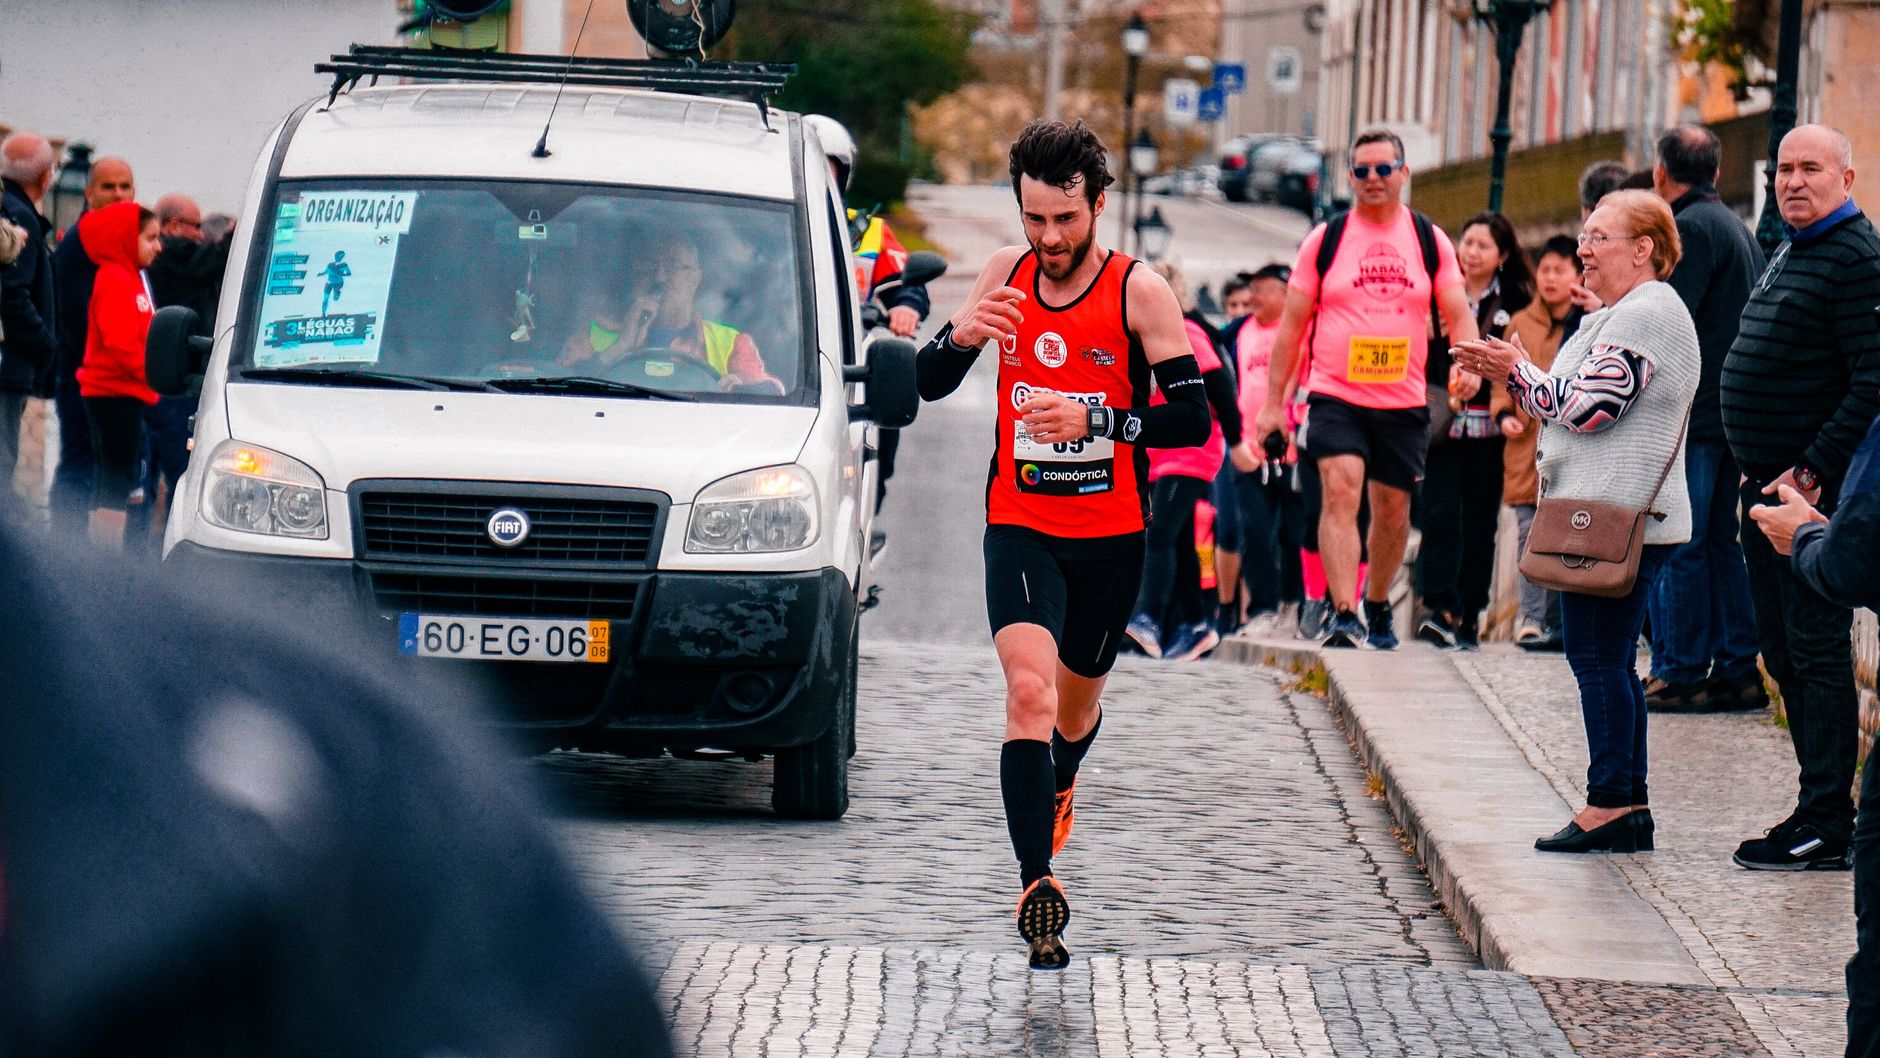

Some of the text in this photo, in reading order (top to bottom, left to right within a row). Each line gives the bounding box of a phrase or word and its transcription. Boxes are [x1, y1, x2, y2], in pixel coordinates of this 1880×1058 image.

[306, 195, 404, 229] ORGANIZAÇÃO
[285, 318, 354, 336] 3 LÉGUAS
[1371, 351, 1388, 366] 30
[1043, 469, 1108, 481] CONDÓPTICA
[494, 521, 521, 534] FIAT
[592, 627, 607, 638] 07
[591, 646, 607, 657] 08
